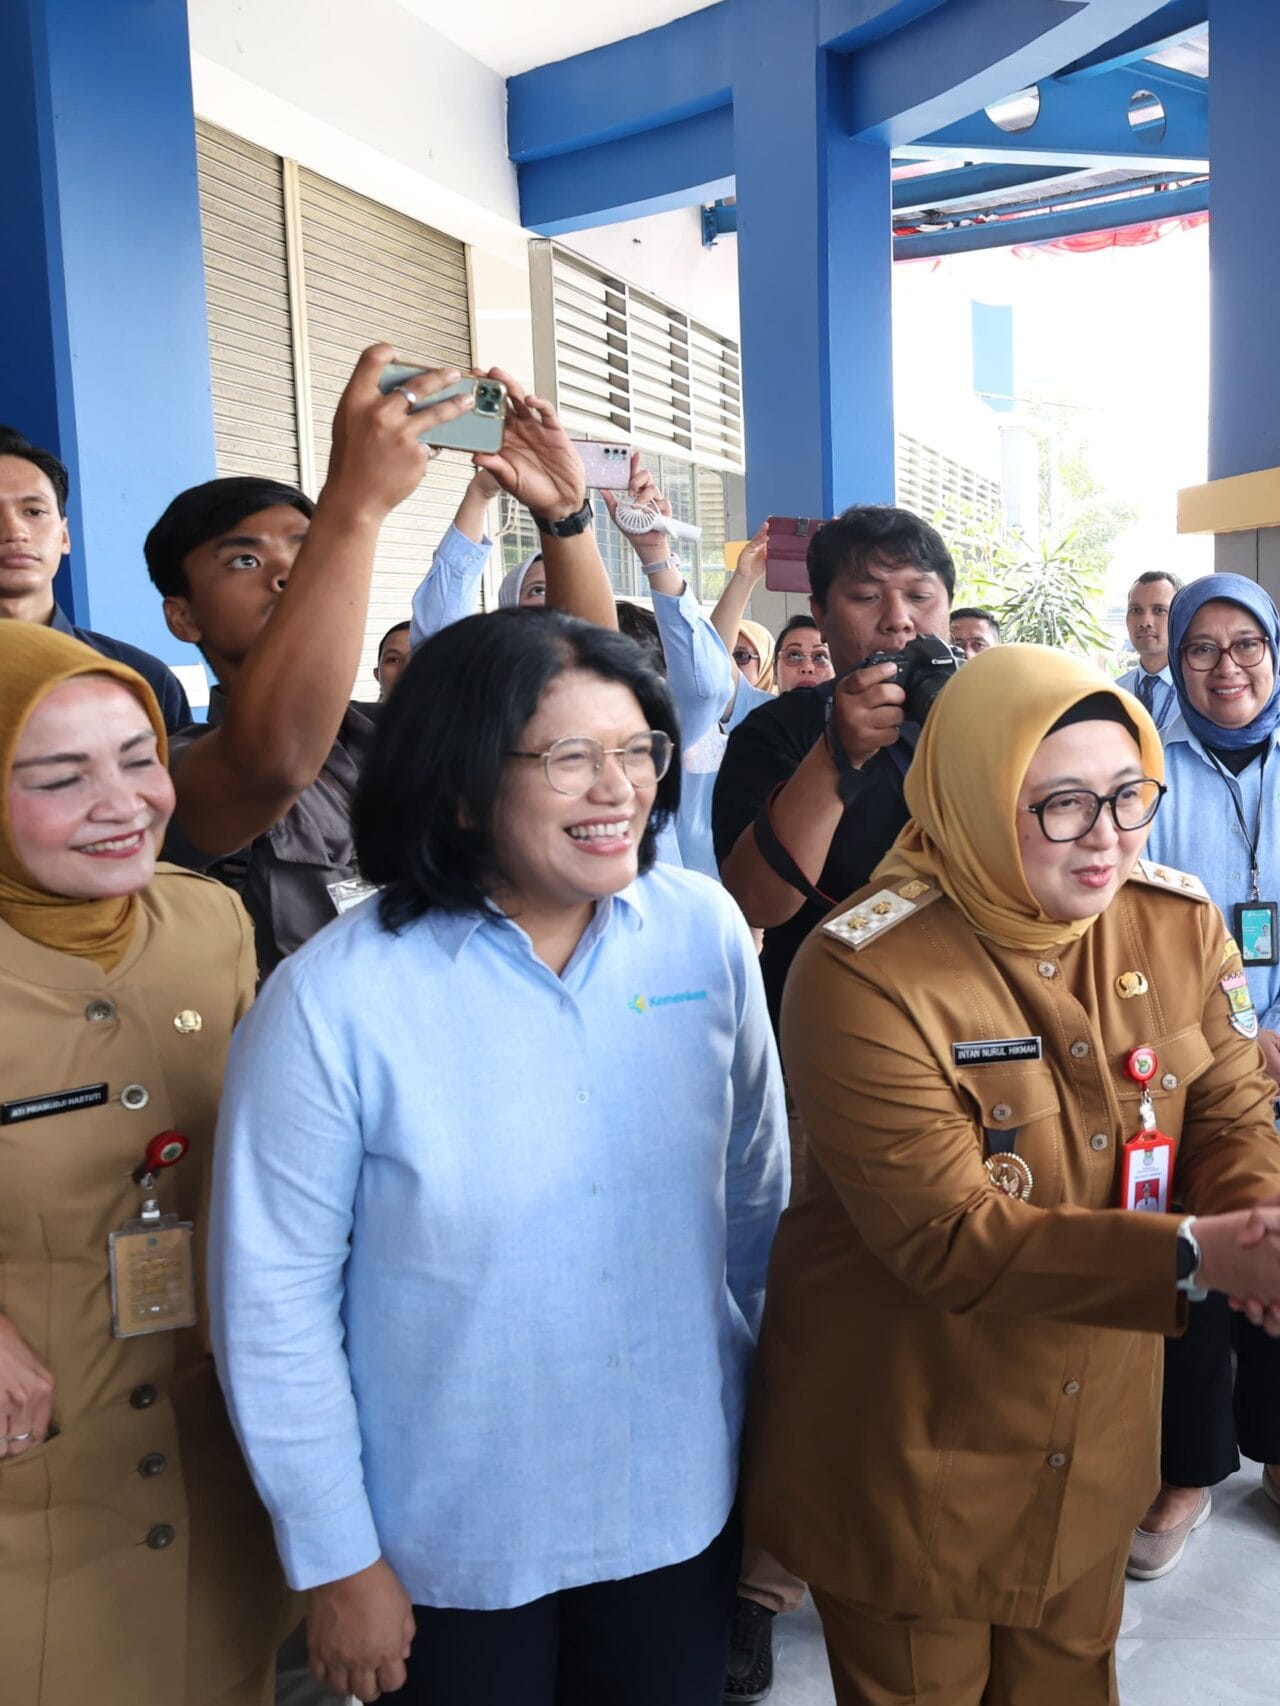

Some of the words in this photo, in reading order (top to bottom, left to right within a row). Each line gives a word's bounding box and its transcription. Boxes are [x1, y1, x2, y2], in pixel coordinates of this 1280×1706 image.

[957, 1048, 980, 1060] INTAN
[981, 1046, 1007, 1058] NURUL
[1007, 1044, 1037, 1055] HIKMAH
[10, 1106, 26, 1118] ATI
